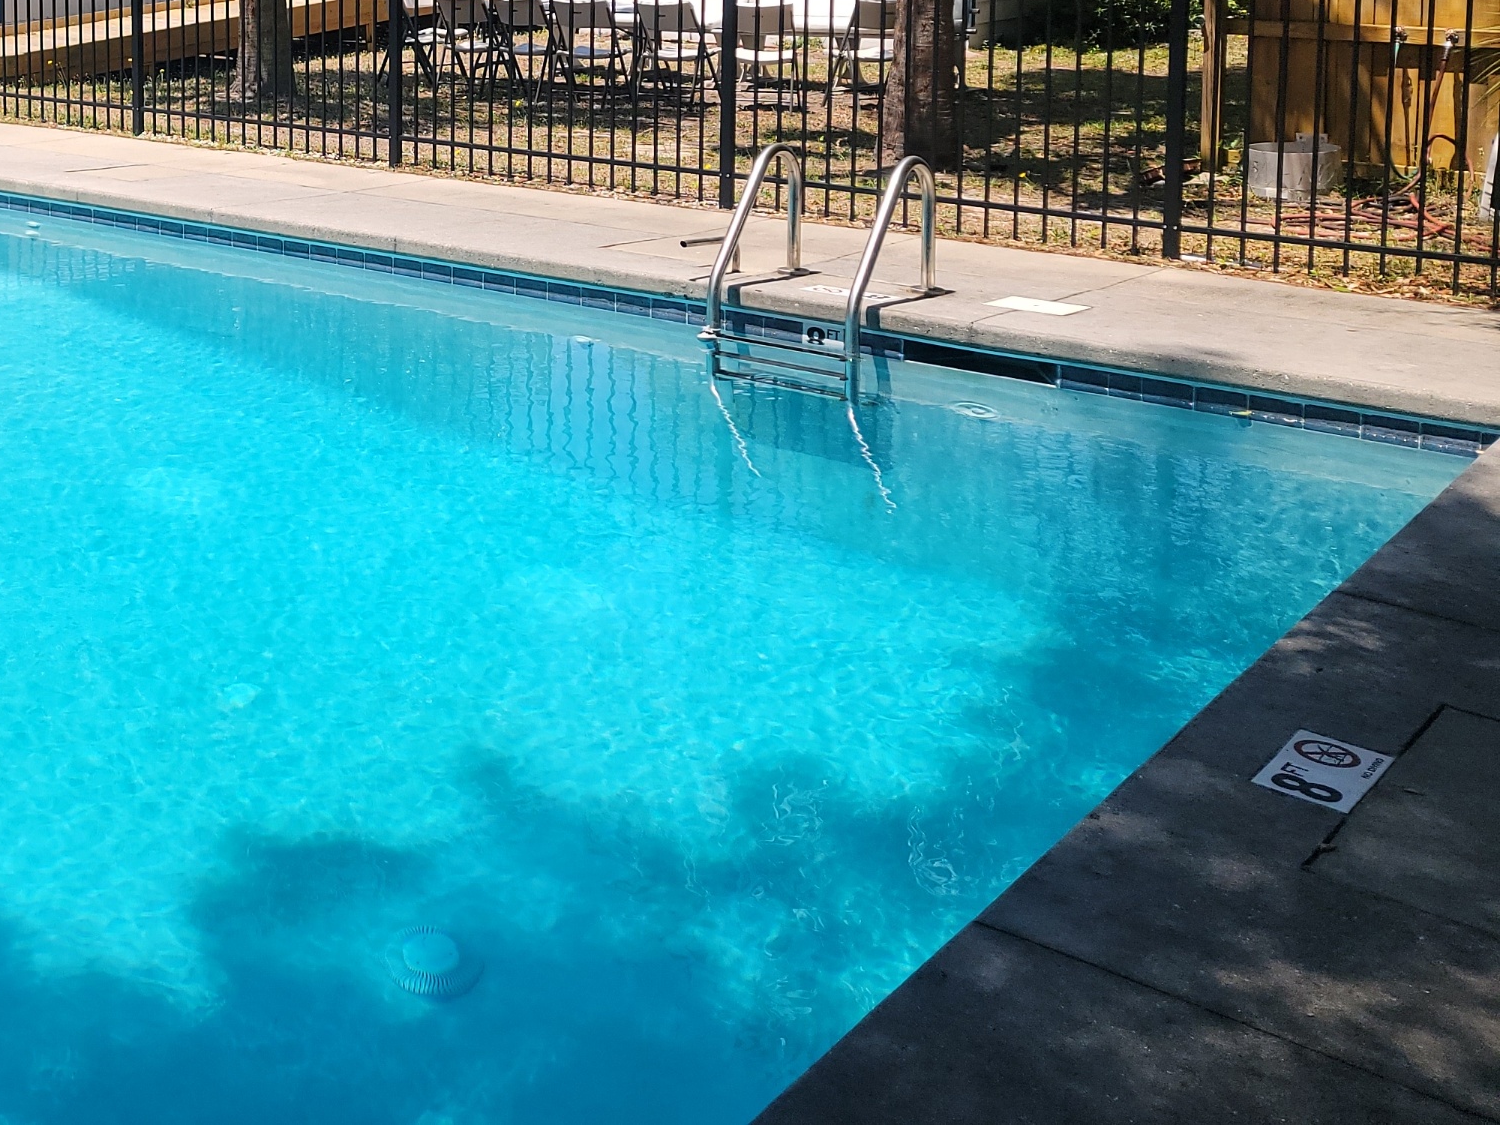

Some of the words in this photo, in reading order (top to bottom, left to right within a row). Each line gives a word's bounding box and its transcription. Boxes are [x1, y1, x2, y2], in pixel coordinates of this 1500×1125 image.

[826, 328, 841, 341] FT
[1280, 761, 1309, 778] FT
[1361, 771, 1373, 779] NO
[1271, 772, 1344, 803] 8
